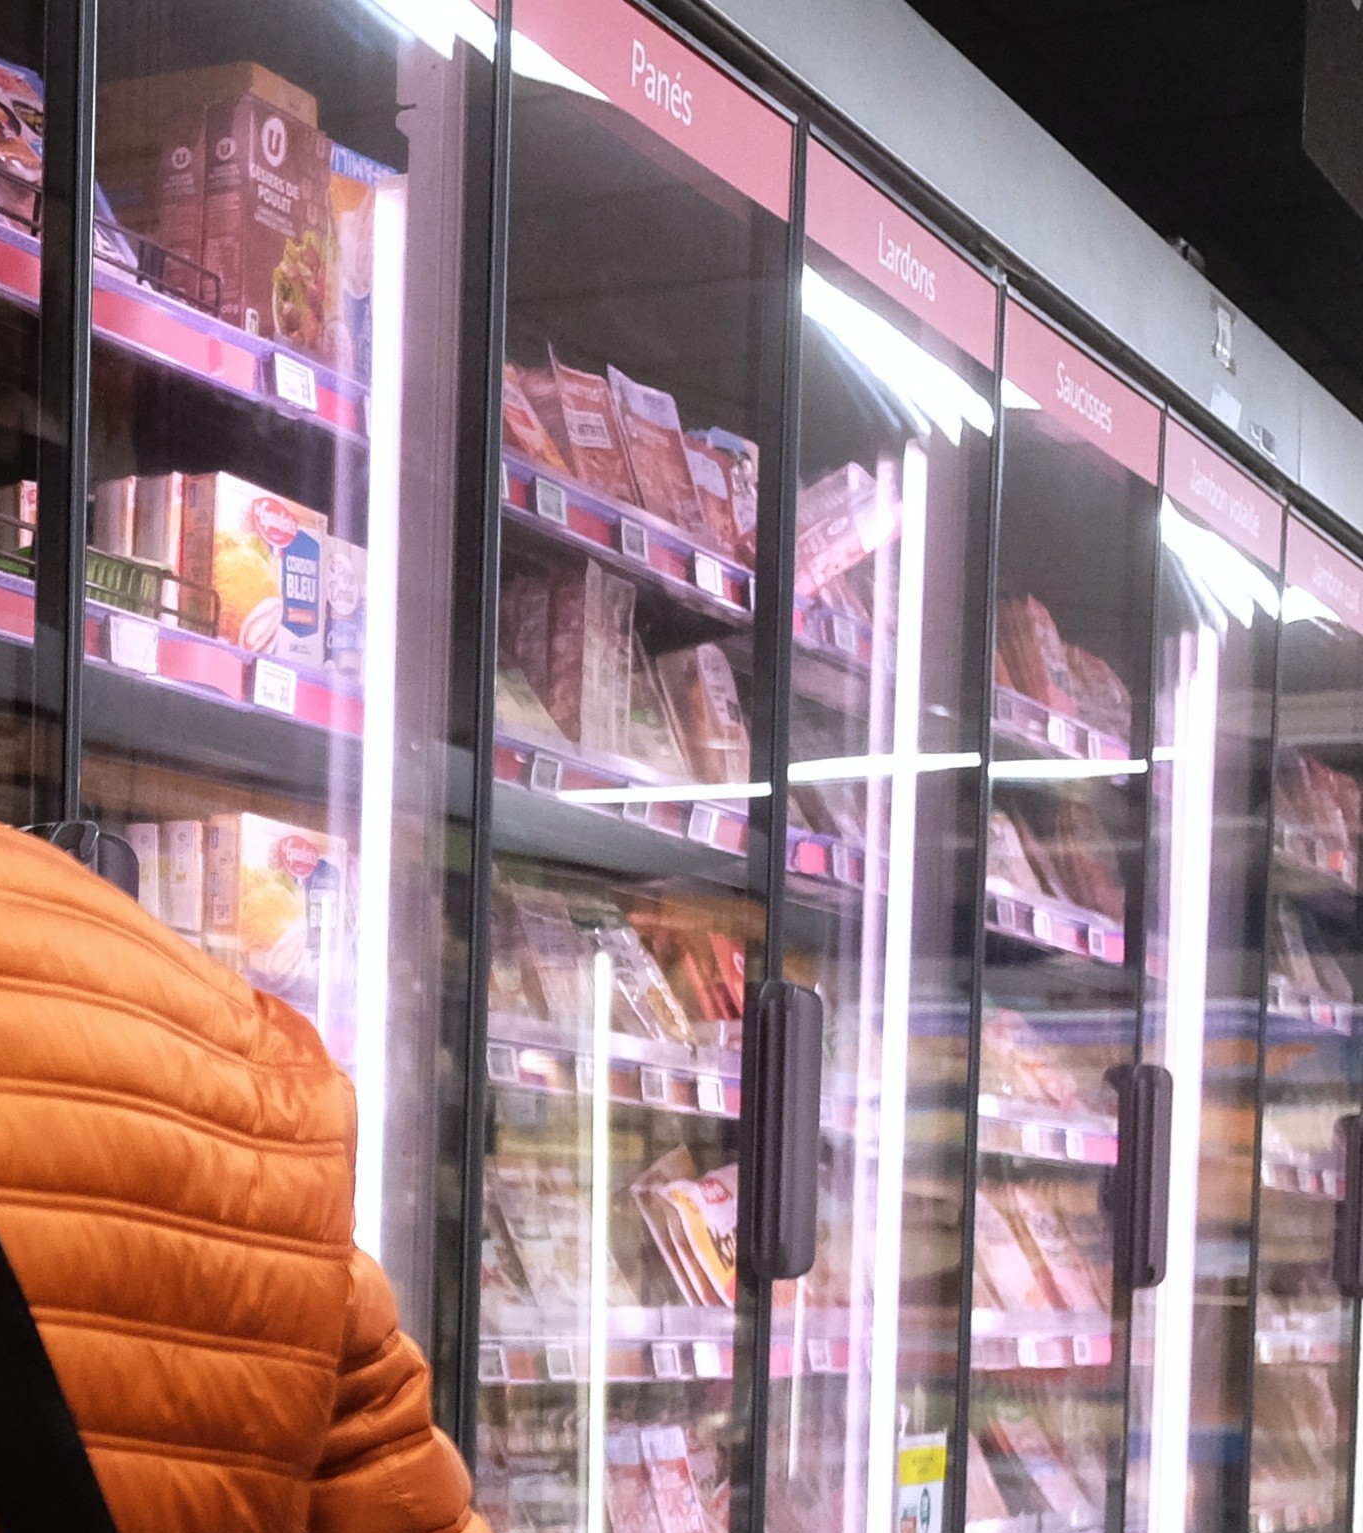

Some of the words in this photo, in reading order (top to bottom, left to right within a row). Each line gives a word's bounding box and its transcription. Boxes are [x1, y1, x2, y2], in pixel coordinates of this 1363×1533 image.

[631, 38, 693, 127] Panés
[877, 221, 936, 302] Lardons
[1056, 361, 1113, 434] Saucisses
[285, 572, 318, 603] BLEU
